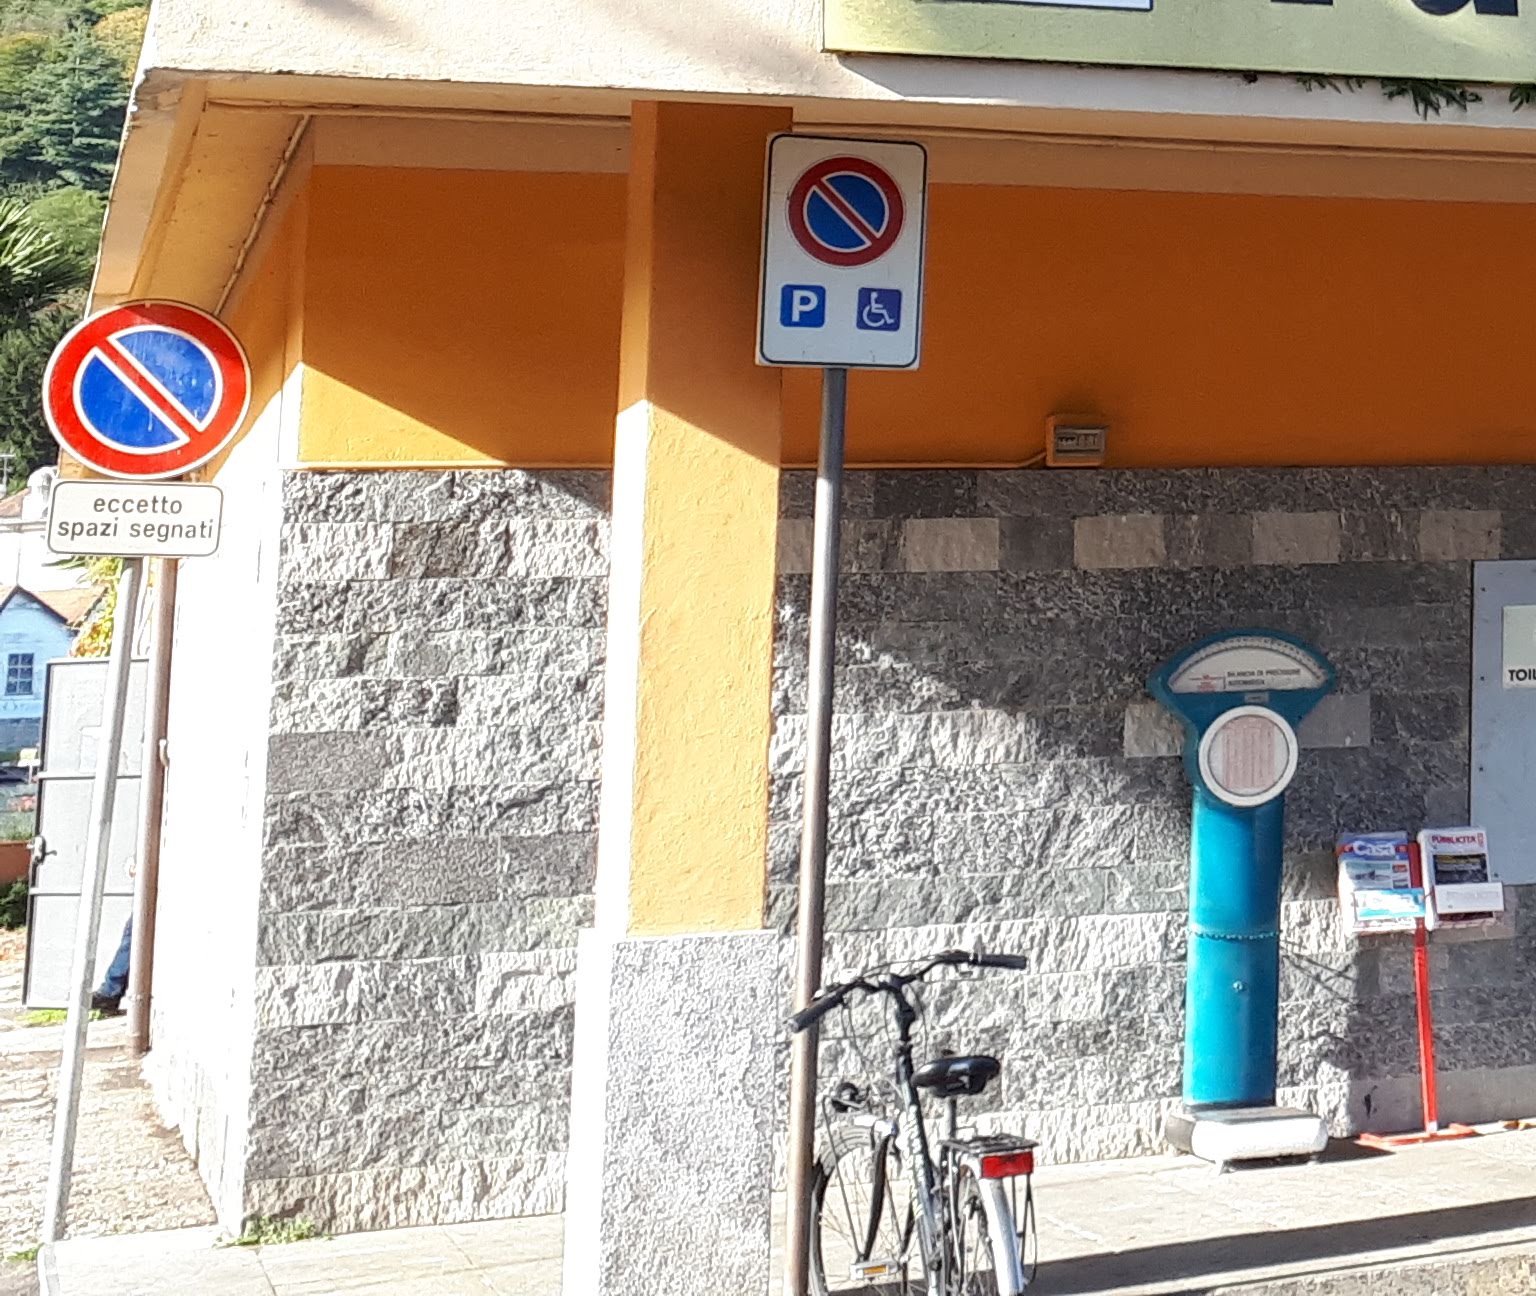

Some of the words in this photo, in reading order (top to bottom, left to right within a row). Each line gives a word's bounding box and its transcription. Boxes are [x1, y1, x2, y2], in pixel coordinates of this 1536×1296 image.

[791, 289, 819, 323] P
[93, 495, 183, 515] eccetto
[57, 517, 119, 541] spazi
[129, 518, 214, 543] segnati
